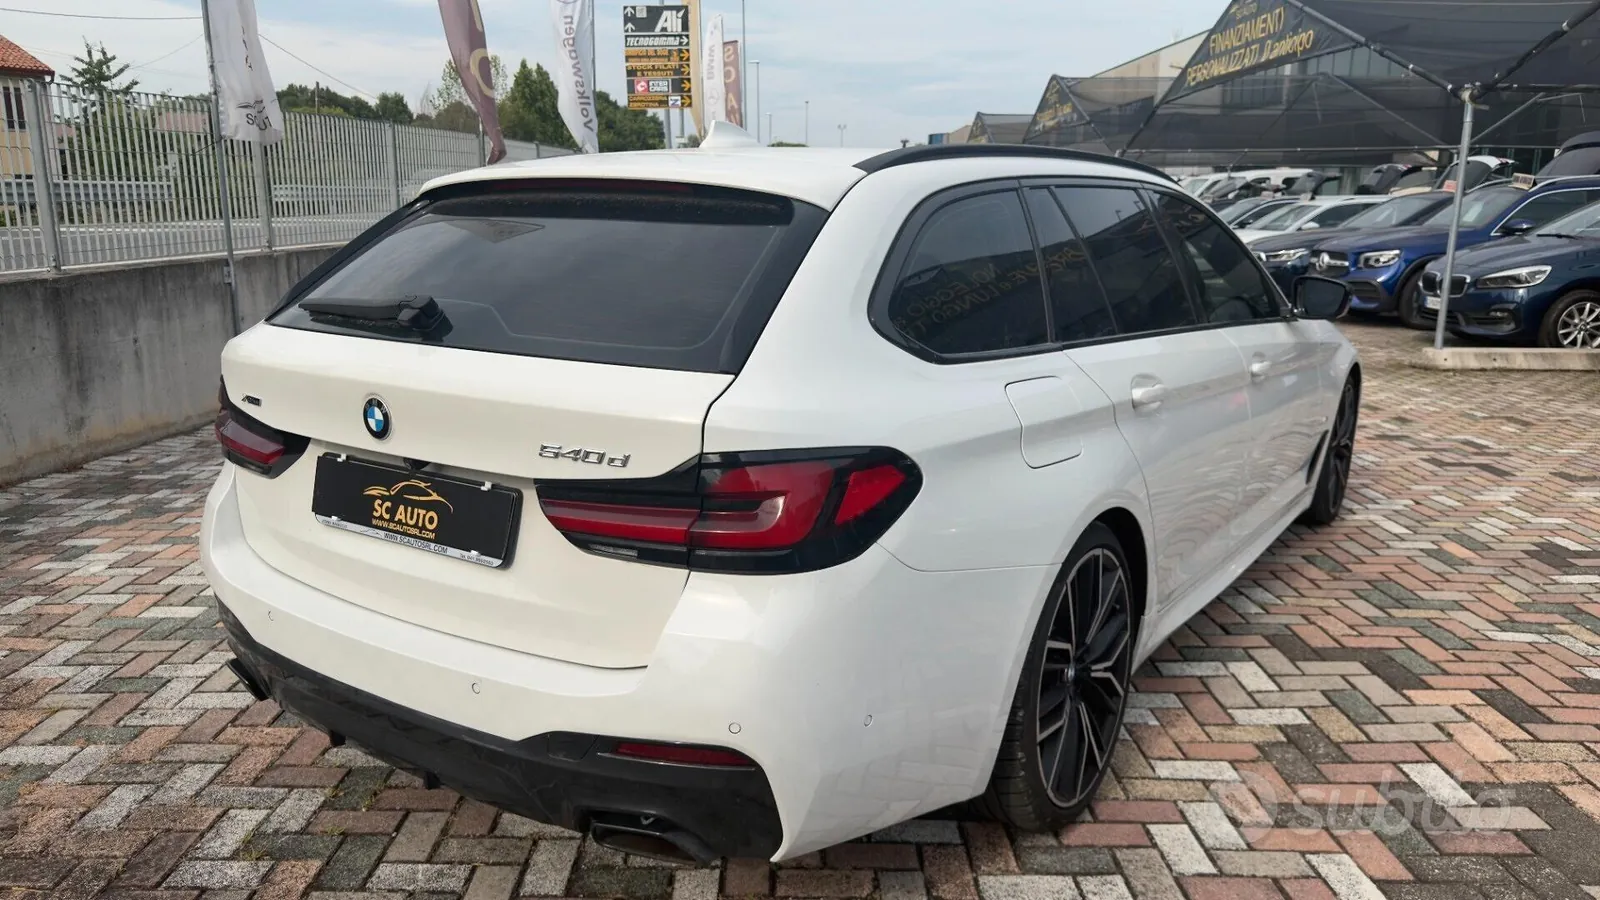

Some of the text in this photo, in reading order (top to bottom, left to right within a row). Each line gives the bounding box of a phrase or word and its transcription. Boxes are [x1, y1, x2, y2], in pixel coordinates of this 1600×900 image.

[1209, 7, 1285, 56] FINANZIAMENTI
[1186, 44, 1260, 87] PERSONALIZZATI
[1269, 28, 1314, 58] anticipo
[371, 518, 436, 540] WWW.SCAUTOSRL.COM
[372, 499, 438, 530] SC AUTO
